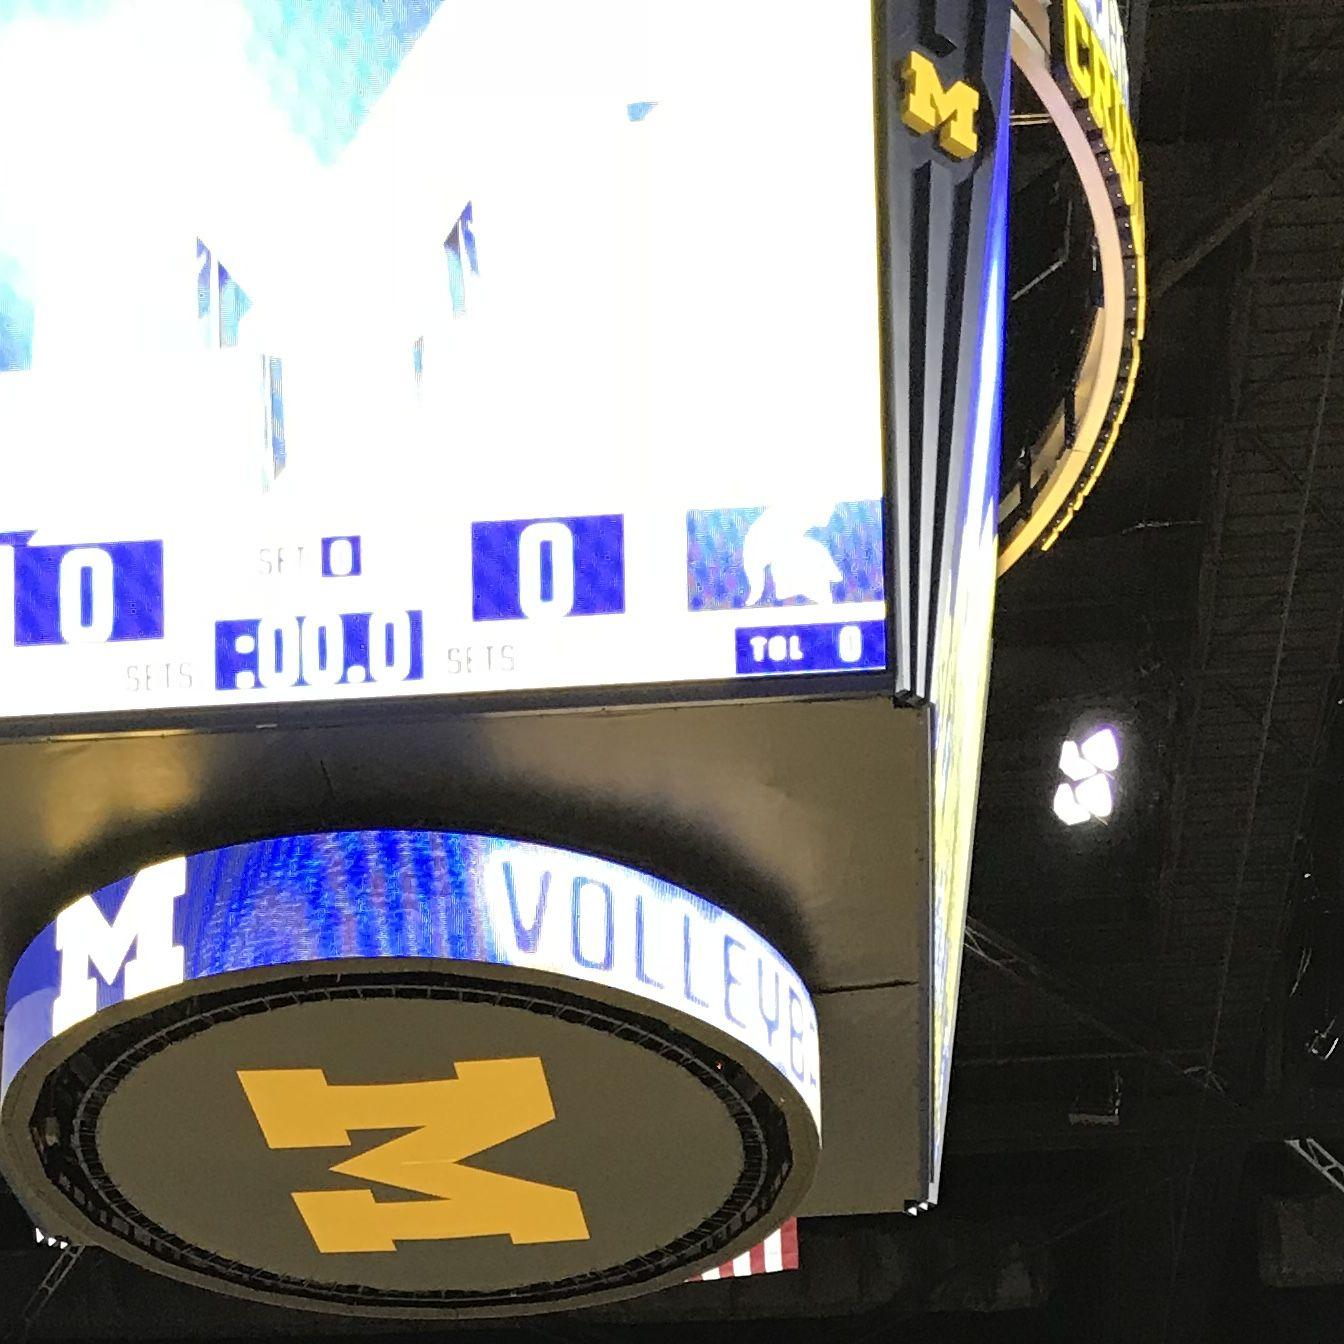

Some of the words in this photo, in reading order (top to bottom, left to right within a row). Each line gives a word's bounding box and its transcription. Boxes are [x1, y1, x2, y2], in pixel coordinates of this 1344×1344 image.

[902, 51, 979, 159] M
[60, 547, 115, 644] 0
[518, 521, 575, 619] 0
[52, 856, 187, 1037] M
[503, 862, 818, 1088] VOLLEYB
[237, 1057, 590, 1253] M
